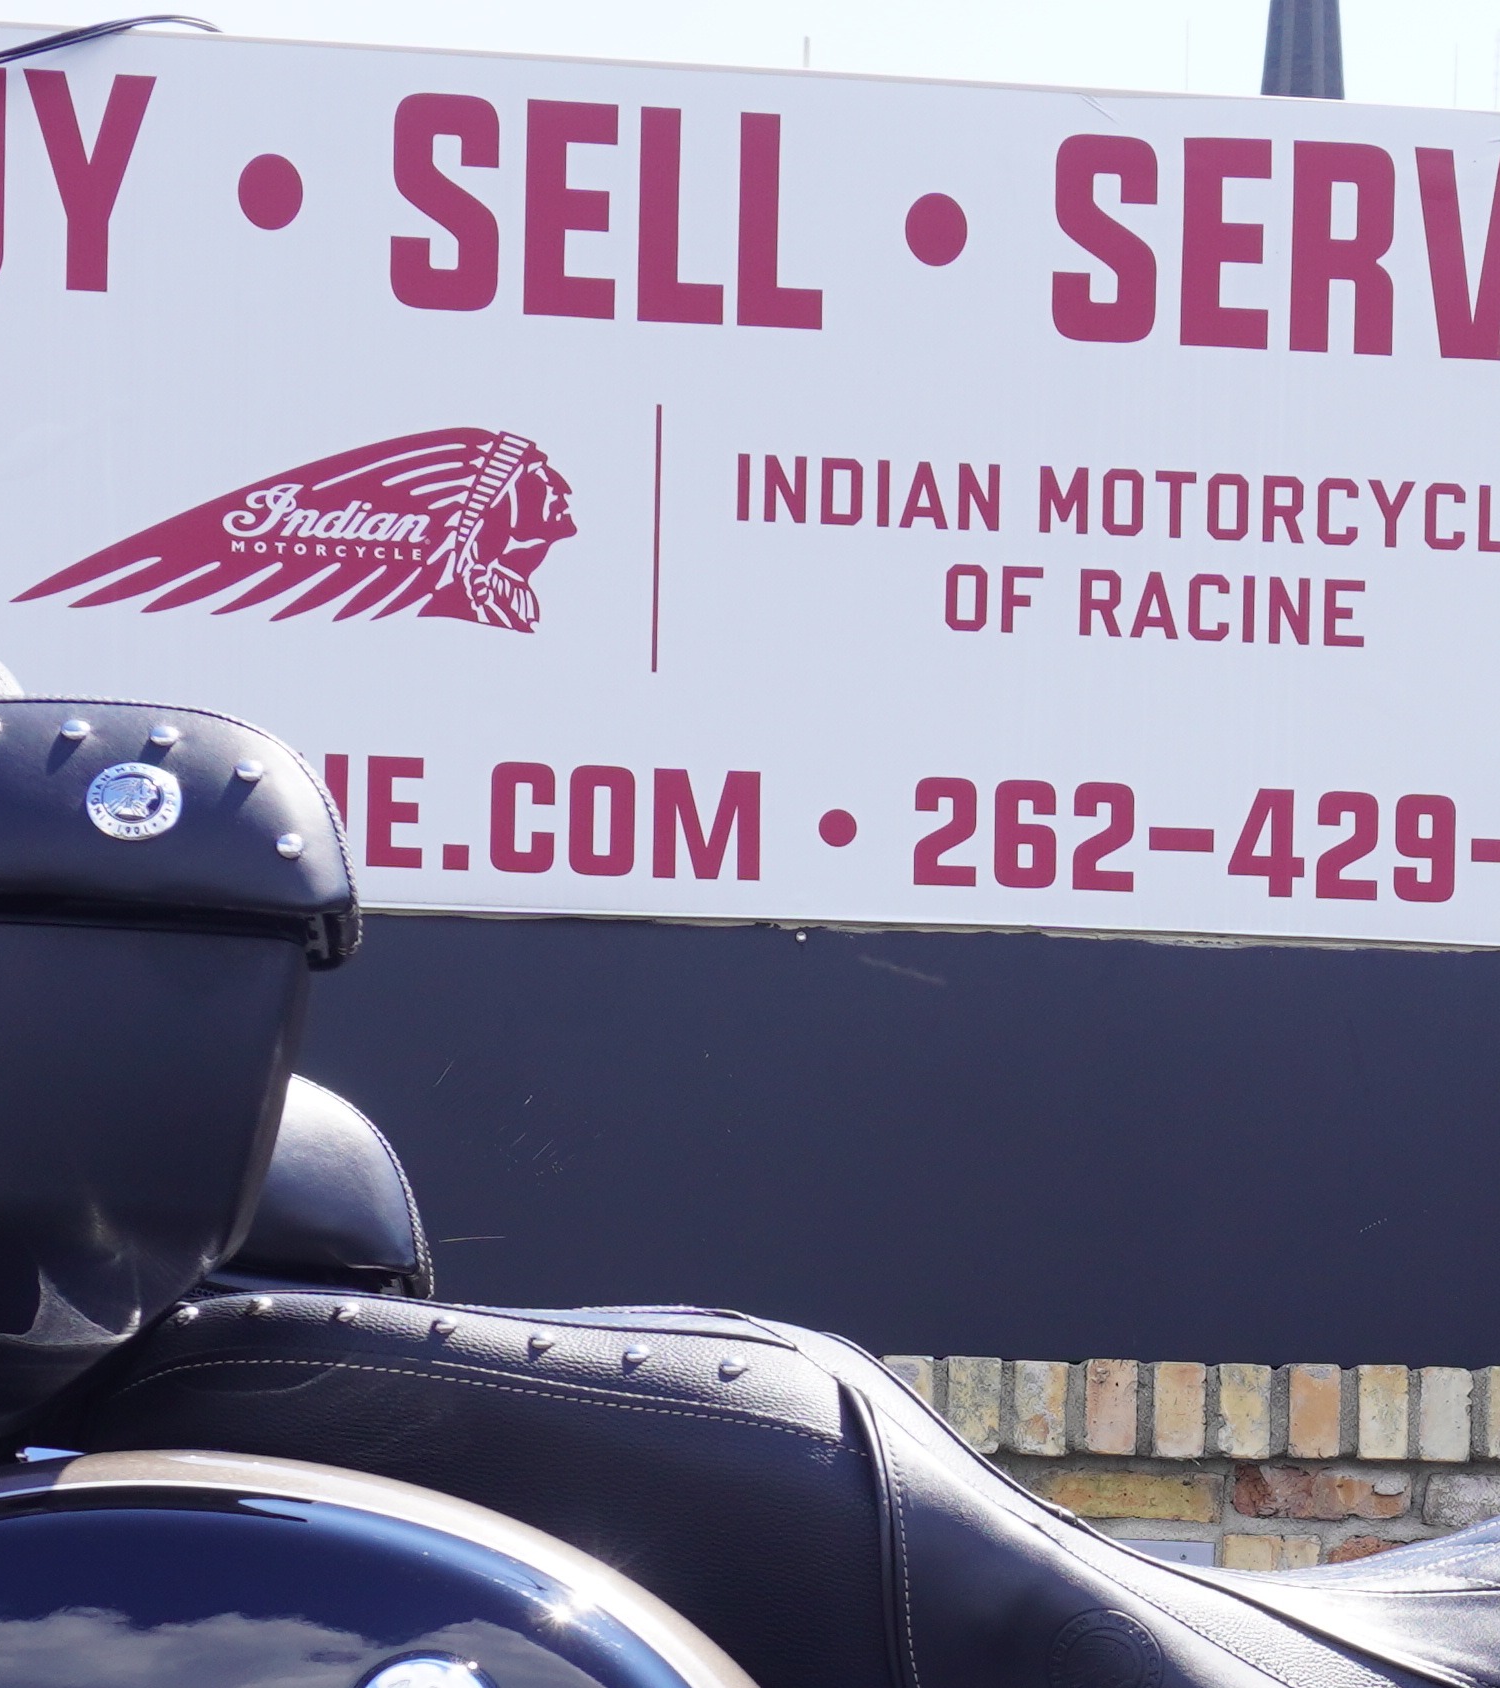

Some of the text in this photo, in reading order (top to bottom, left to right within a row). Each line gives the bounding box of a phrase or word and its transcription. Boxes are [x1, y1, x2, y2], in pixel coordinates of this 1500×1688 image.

[391, 94, 822, 329] SELL
[222, 483, 431, 543] Indian
[738, 455, 999, 530] INDIAN
[231, 540, 422, 561] MOTORCYCLE
[946, 565, 1364, 646] OF RACINE
